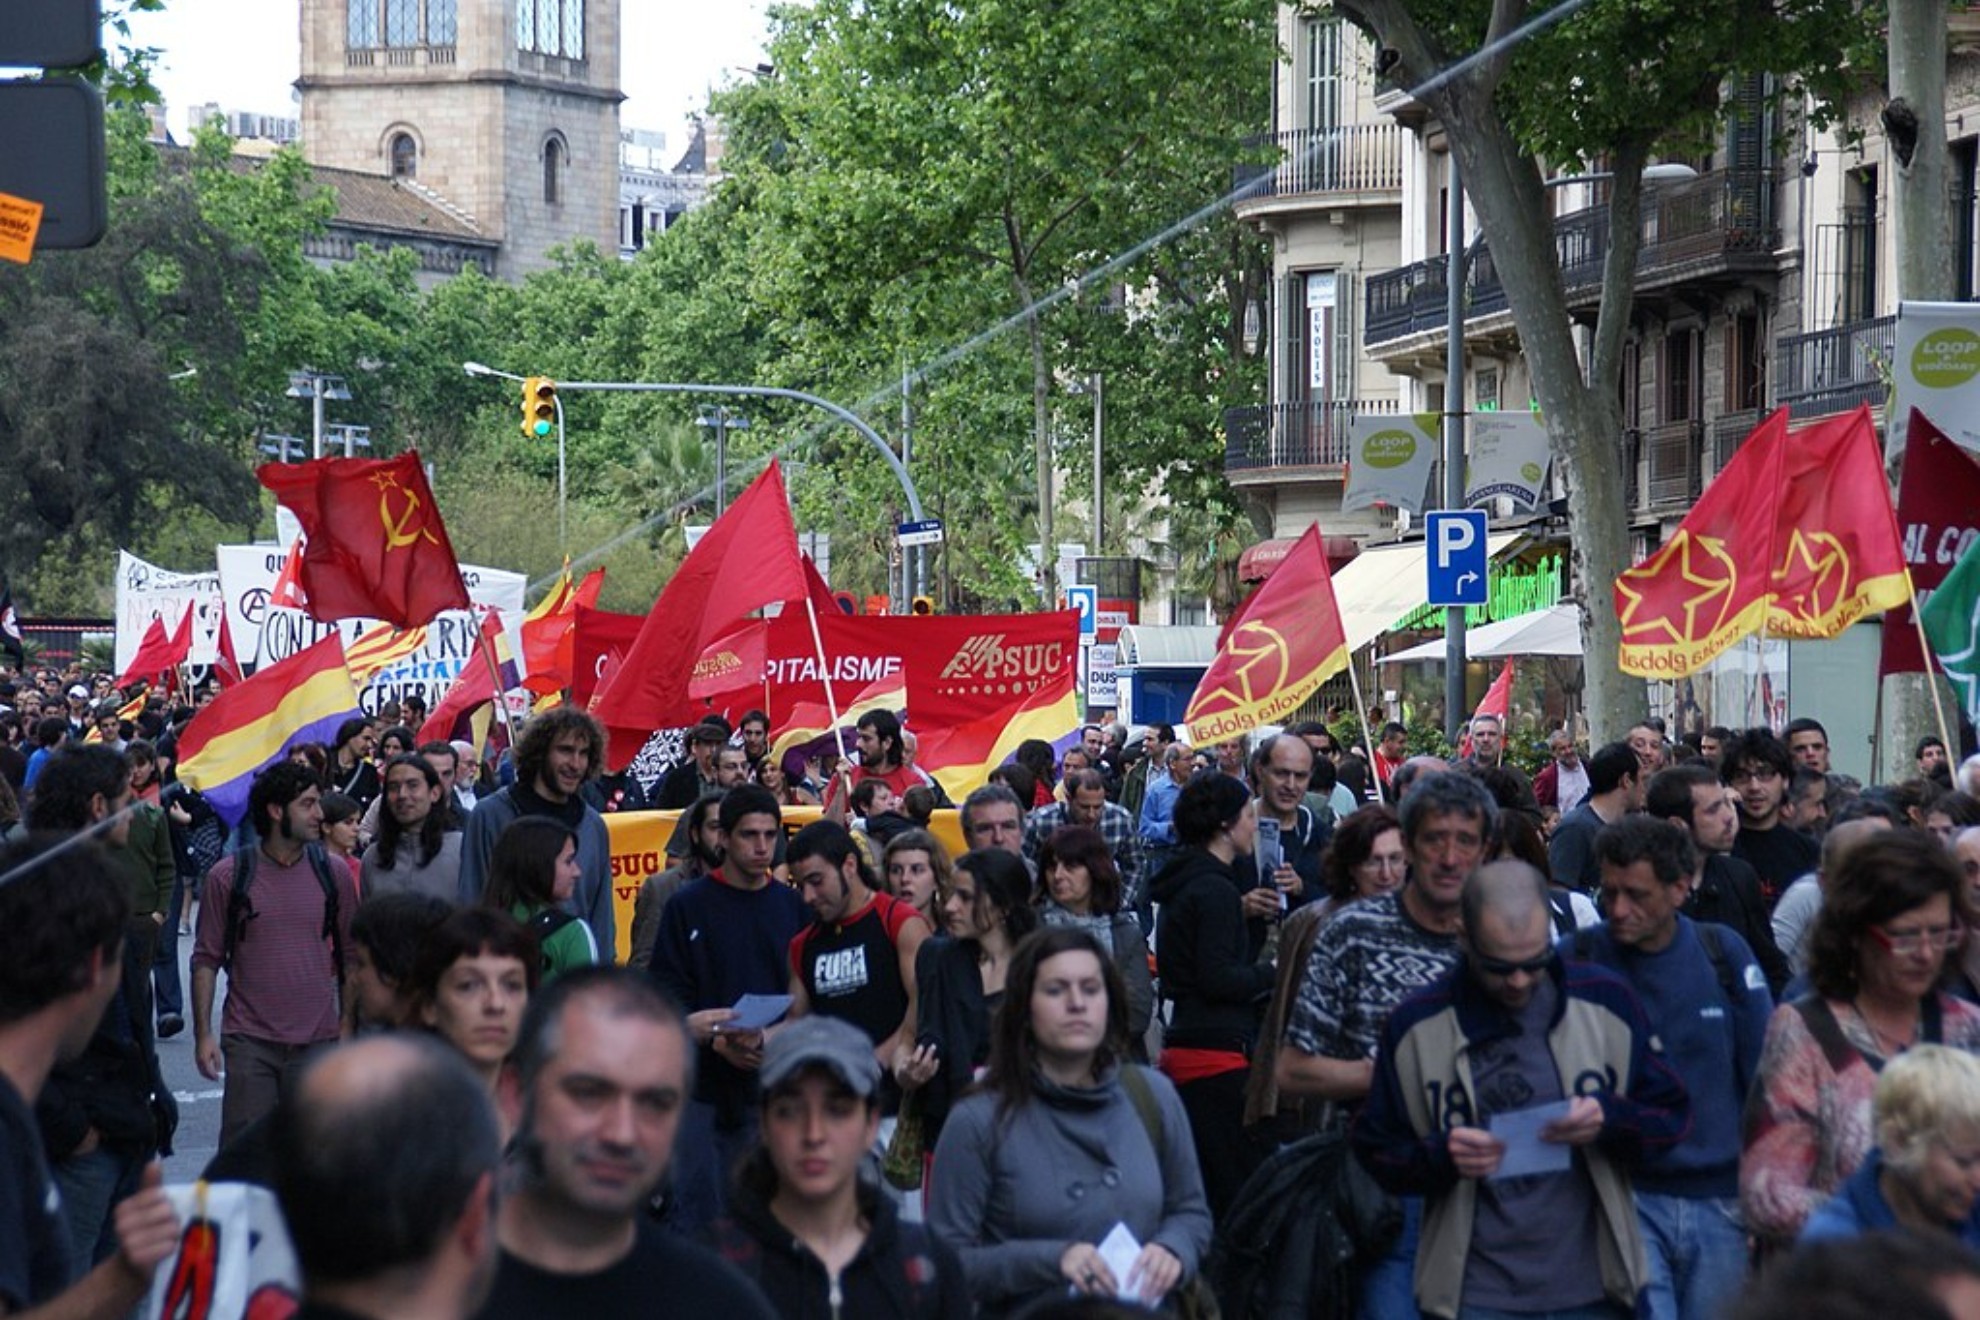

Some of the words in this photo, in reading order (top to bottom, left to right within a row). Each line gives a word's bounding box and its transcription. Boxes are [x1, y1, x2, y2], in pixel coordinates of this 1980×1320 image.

[1922, 341, 1978, 354] LOOP
[1369, 436, 1411, 447] LOOP
[1438, 518, 1475, 568] P
[760, 655, 902, 684] PITALISME
[984, 642, 1061, 679] PSUC
